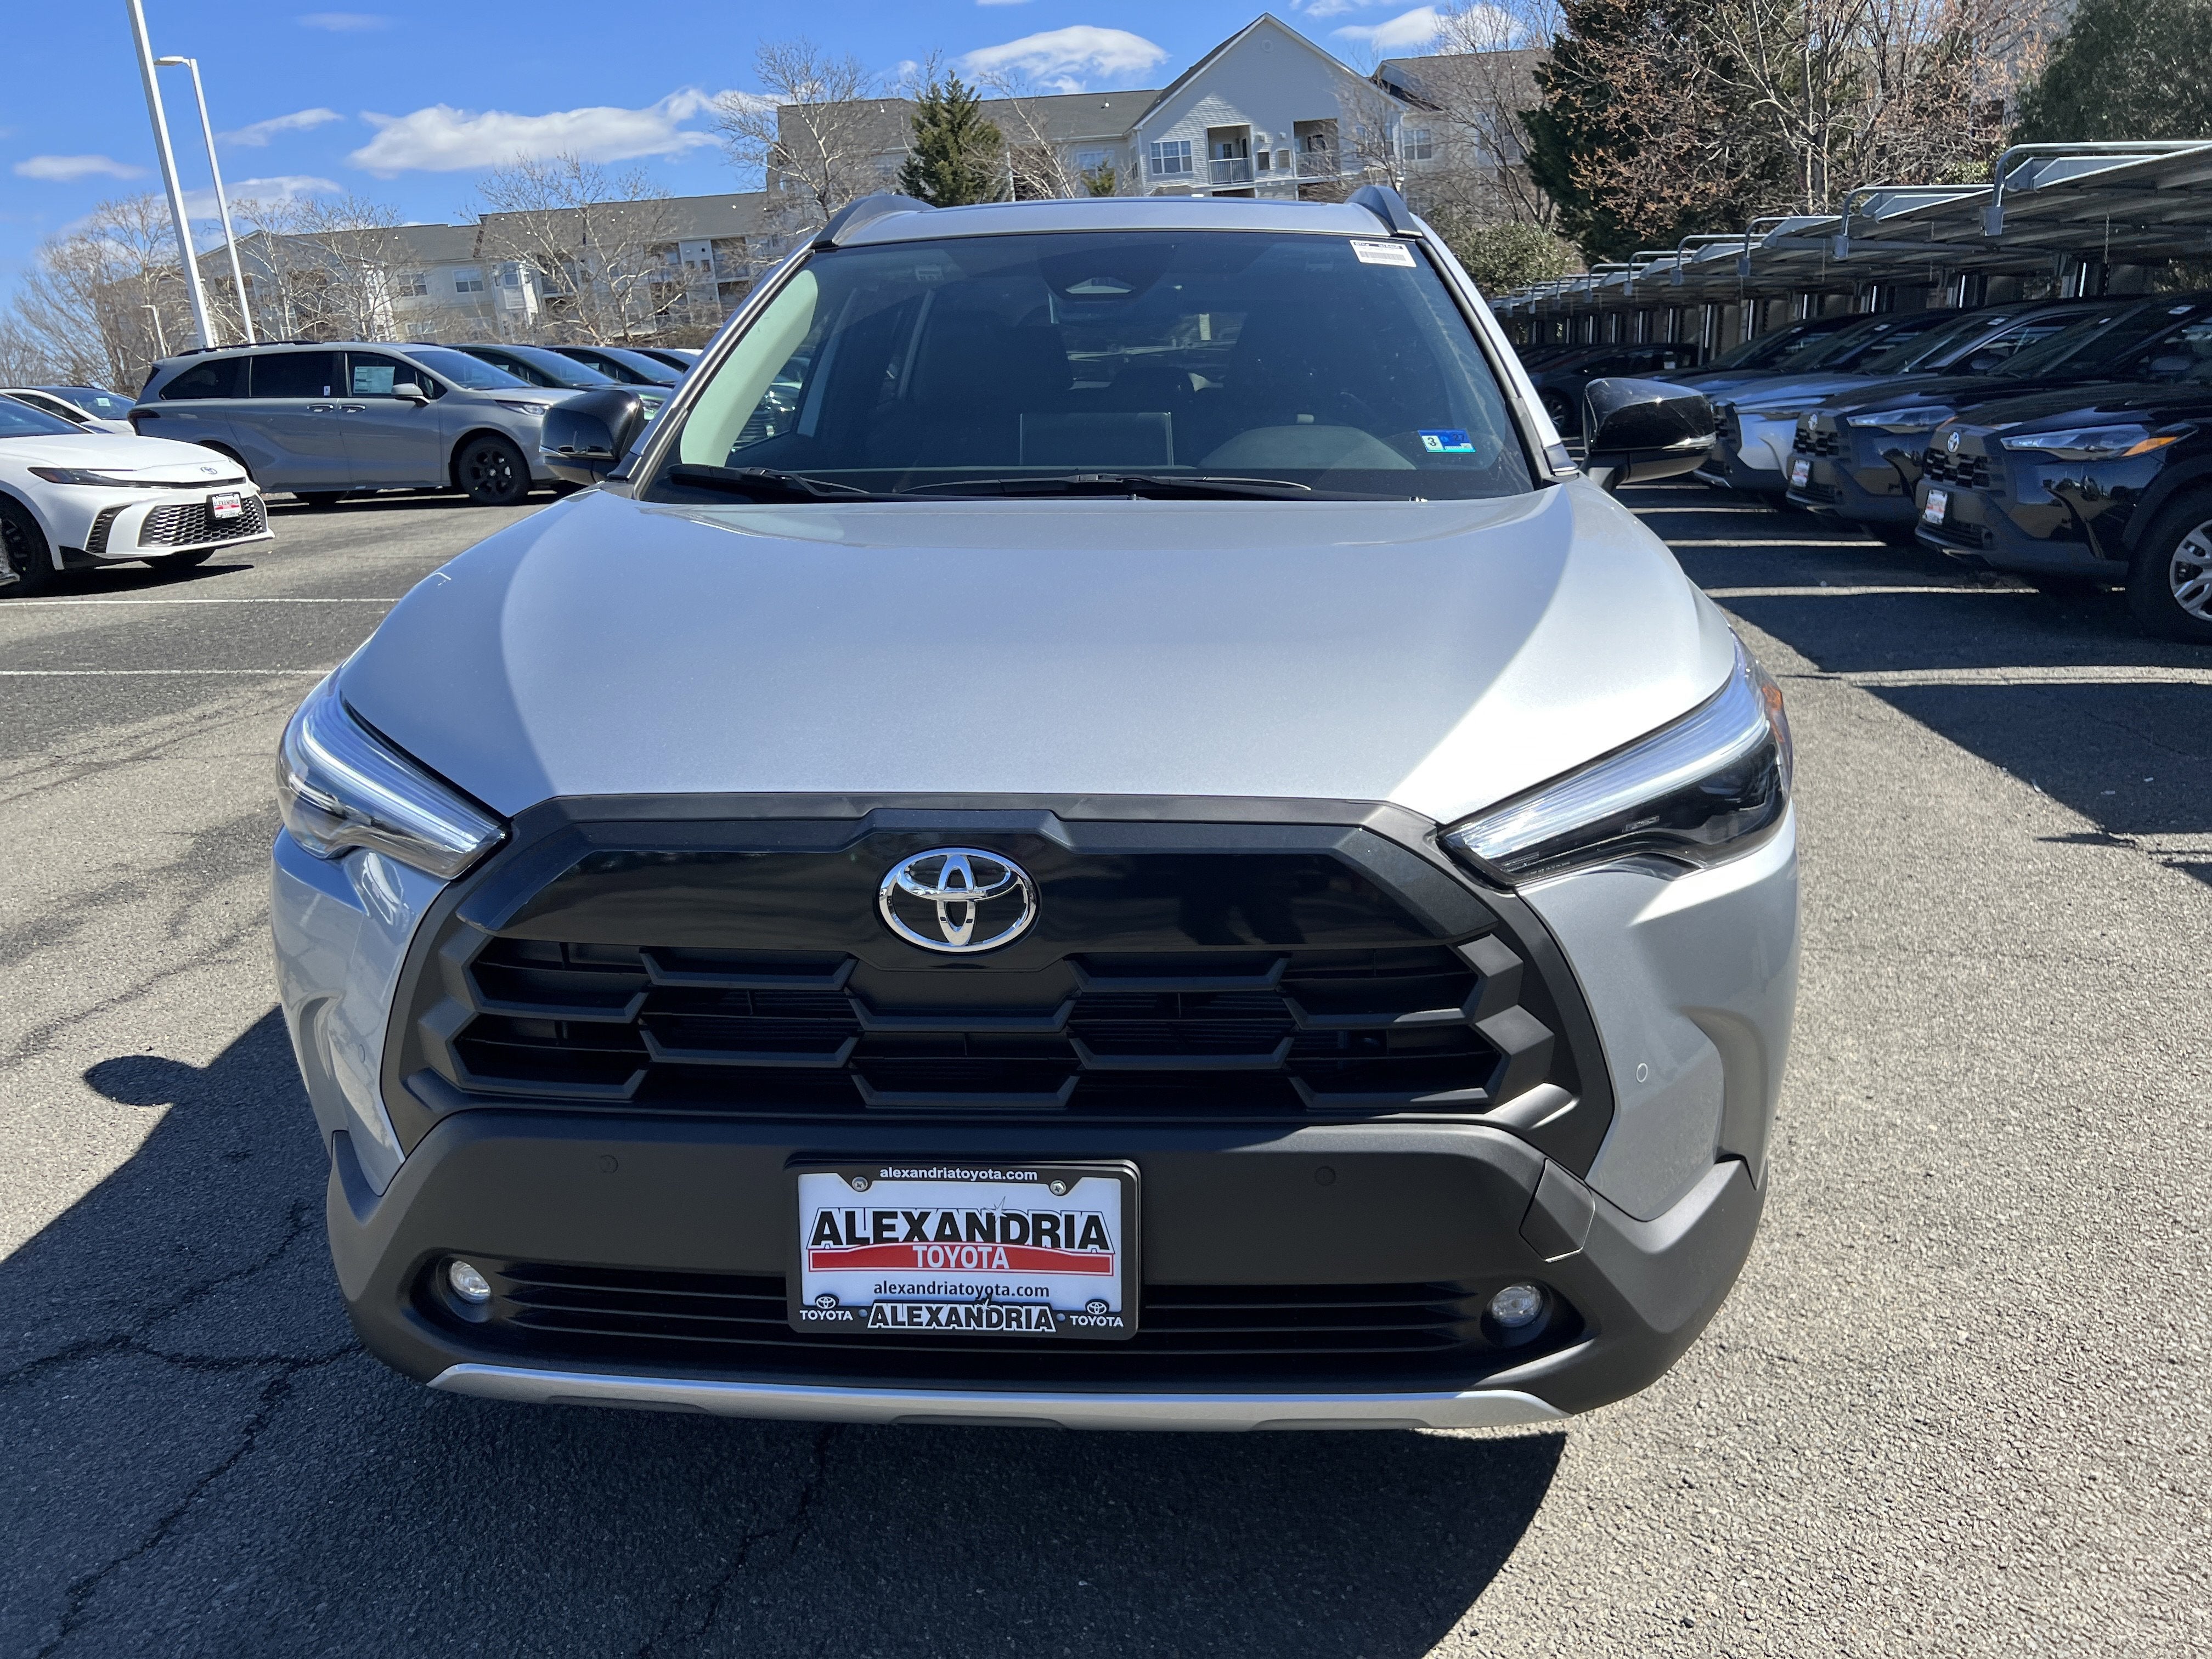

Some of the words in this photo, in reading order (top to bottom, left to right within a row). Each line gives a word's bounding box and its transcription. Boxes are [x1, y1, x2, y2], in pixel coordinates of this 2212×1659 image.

[1427, 437, 1437, 446] 3
[879, 1166, 1038, 1181] alexandriatoyota.com
[808, 1209, 1113, 1252] ALEXANDRIA
[912, 1245, 1009, 1269] TOYOTA
[873, 1280, 1049, 1299] alexandriatoyota.com
[799, 1310, 853, 1321] TOYOTA
[867, 1302, 1057, 1332] ALEXANDRIA
[1070, 1315, 1124, 1328] TOYOTA
